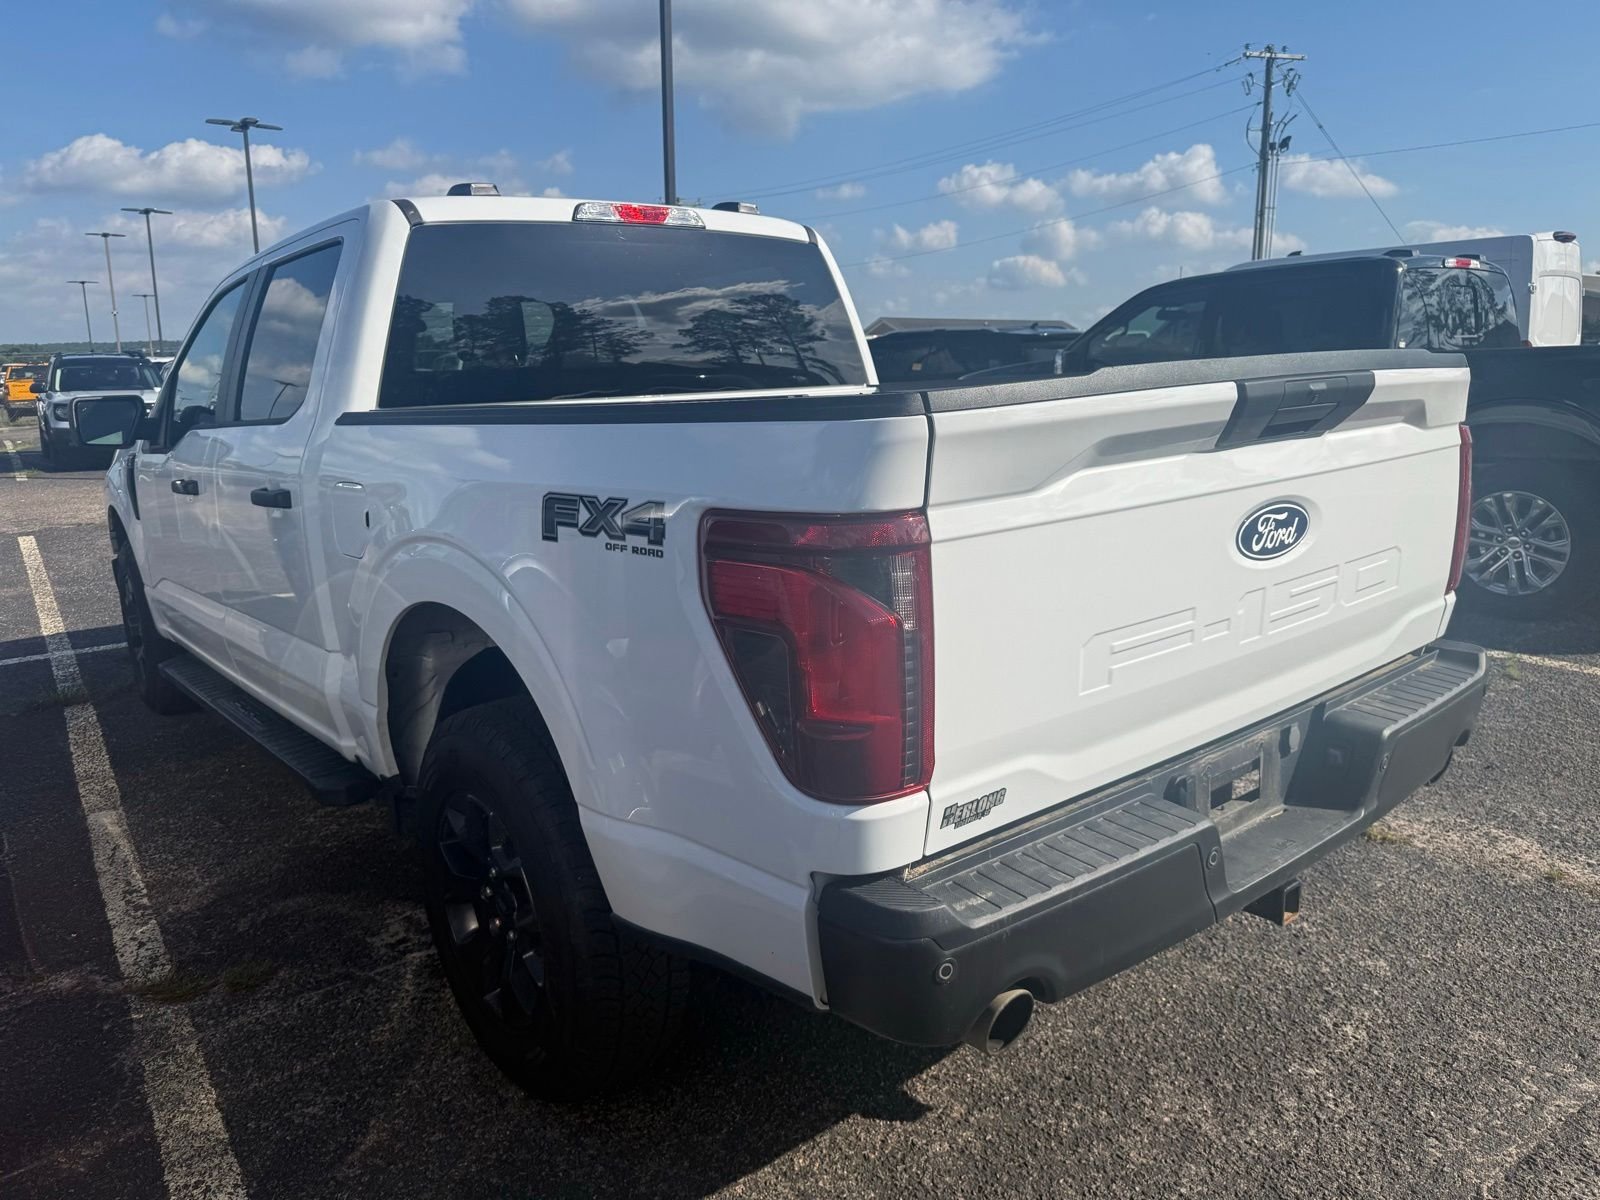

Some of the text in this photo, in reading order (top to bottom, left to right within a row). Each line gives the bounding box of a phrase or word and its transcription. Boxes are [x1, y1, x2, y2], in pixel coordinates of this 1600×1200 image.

[541, 491, 666, 546] FX4
[1252, 511, 1299, 552] Ford
[604, 542, 664, 558] OFF ROAD
[1078, 545, 1402, 696] F-150
